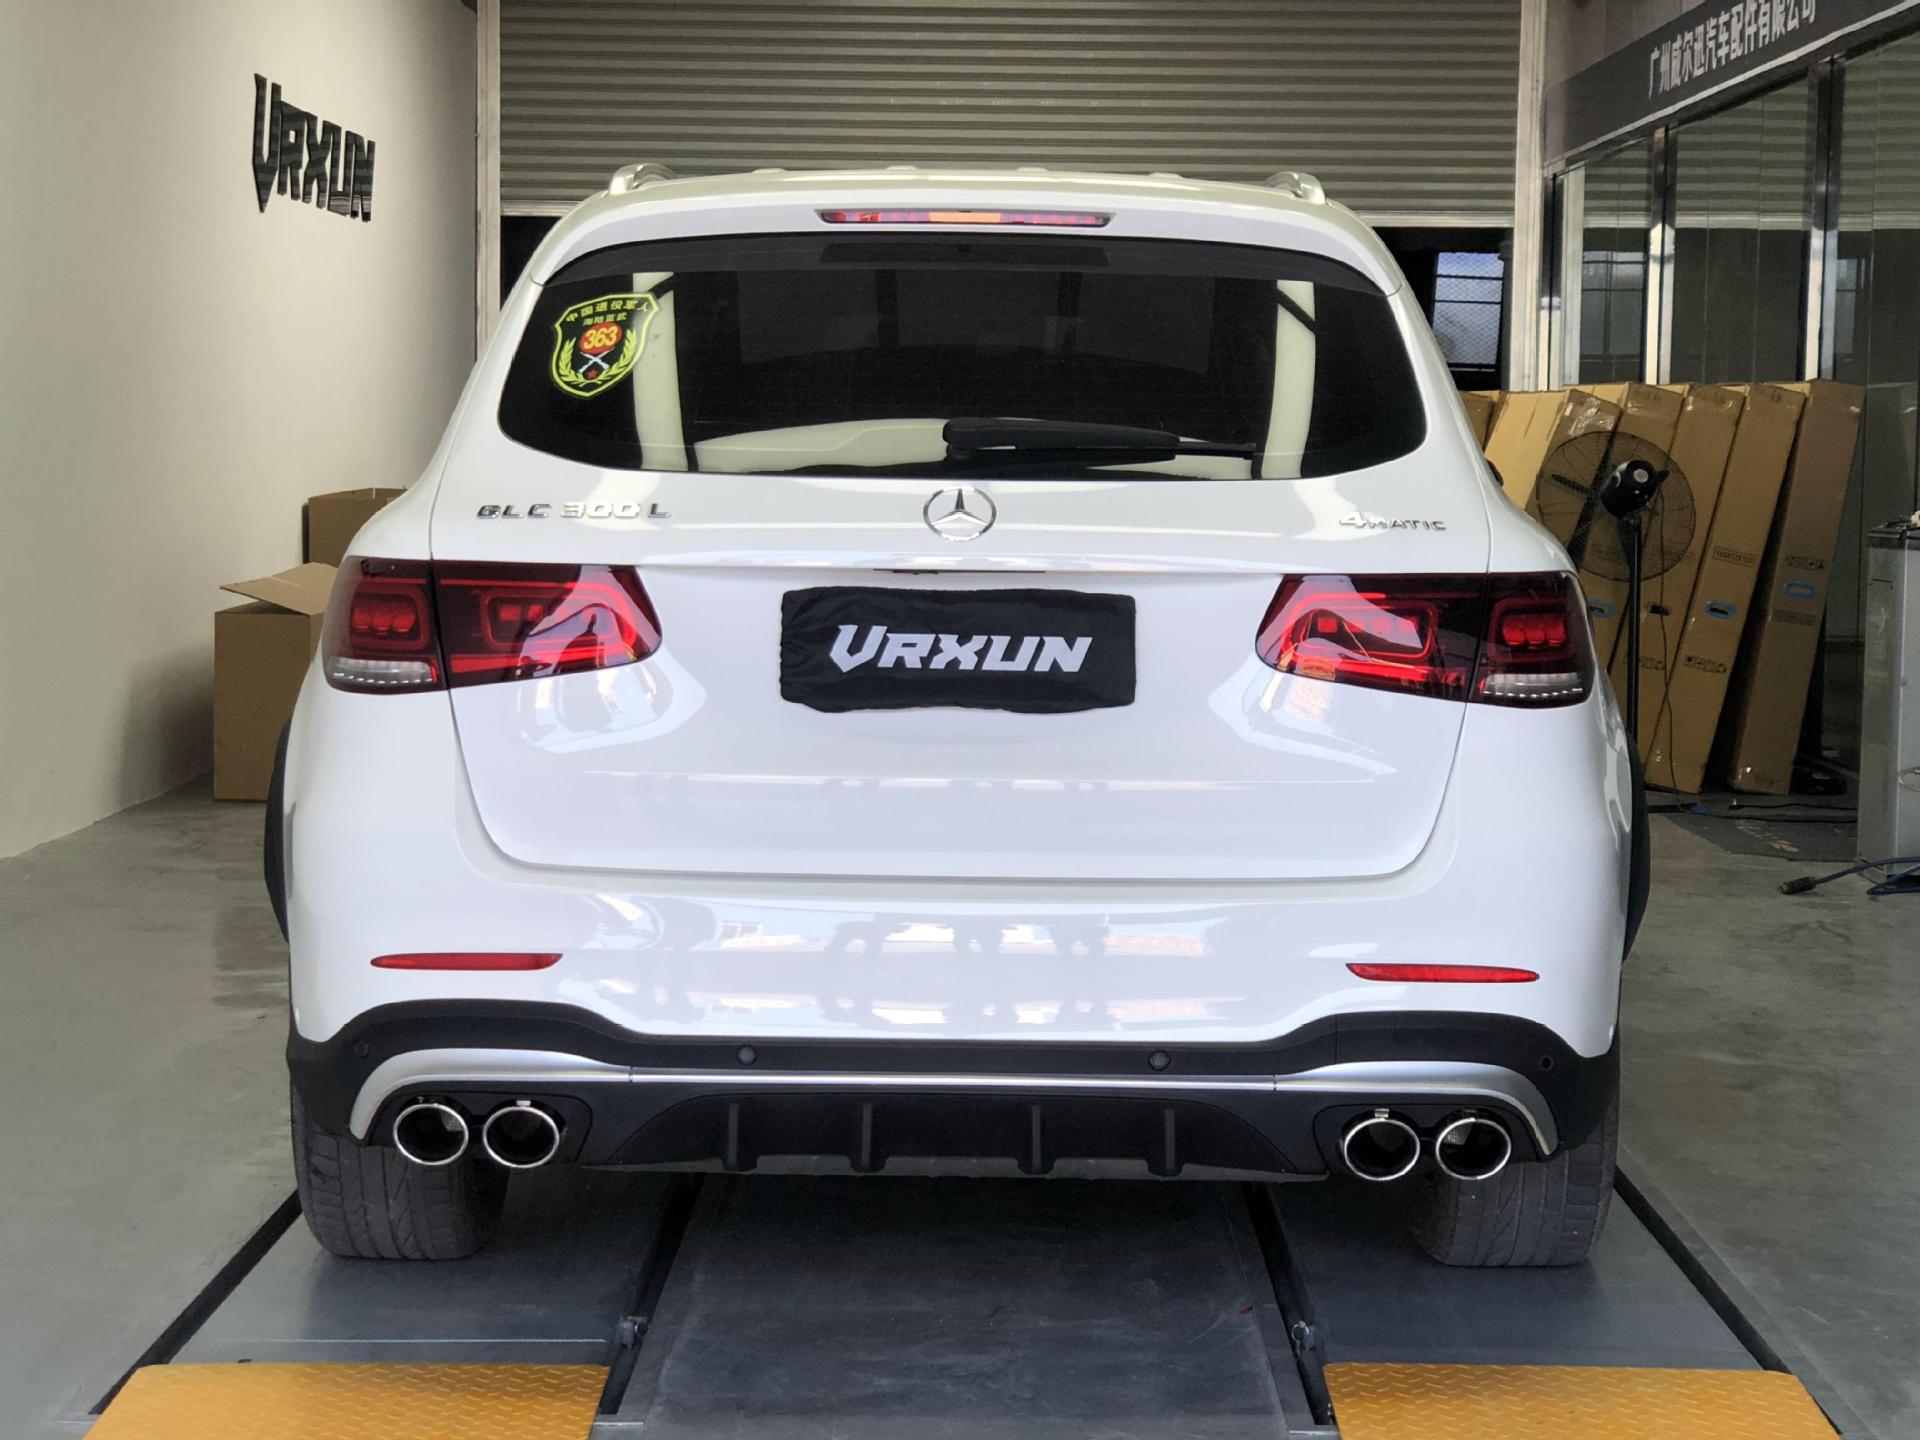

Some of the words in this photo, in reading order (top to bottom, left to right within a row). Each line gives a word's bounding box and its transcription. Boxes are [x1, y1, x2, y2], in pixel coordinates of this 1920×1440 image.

[253, 73, 376, 222] VRXUN
[583, 325, 618, 350] 363
[477, 503, 552, 519] GLC
[560, 502, 640, 519] 300
[648, 503, 672, 519] L
[1340, 511, 1446, 532] 4MATIC
[829, 624, 1093, 673] VRXUN
